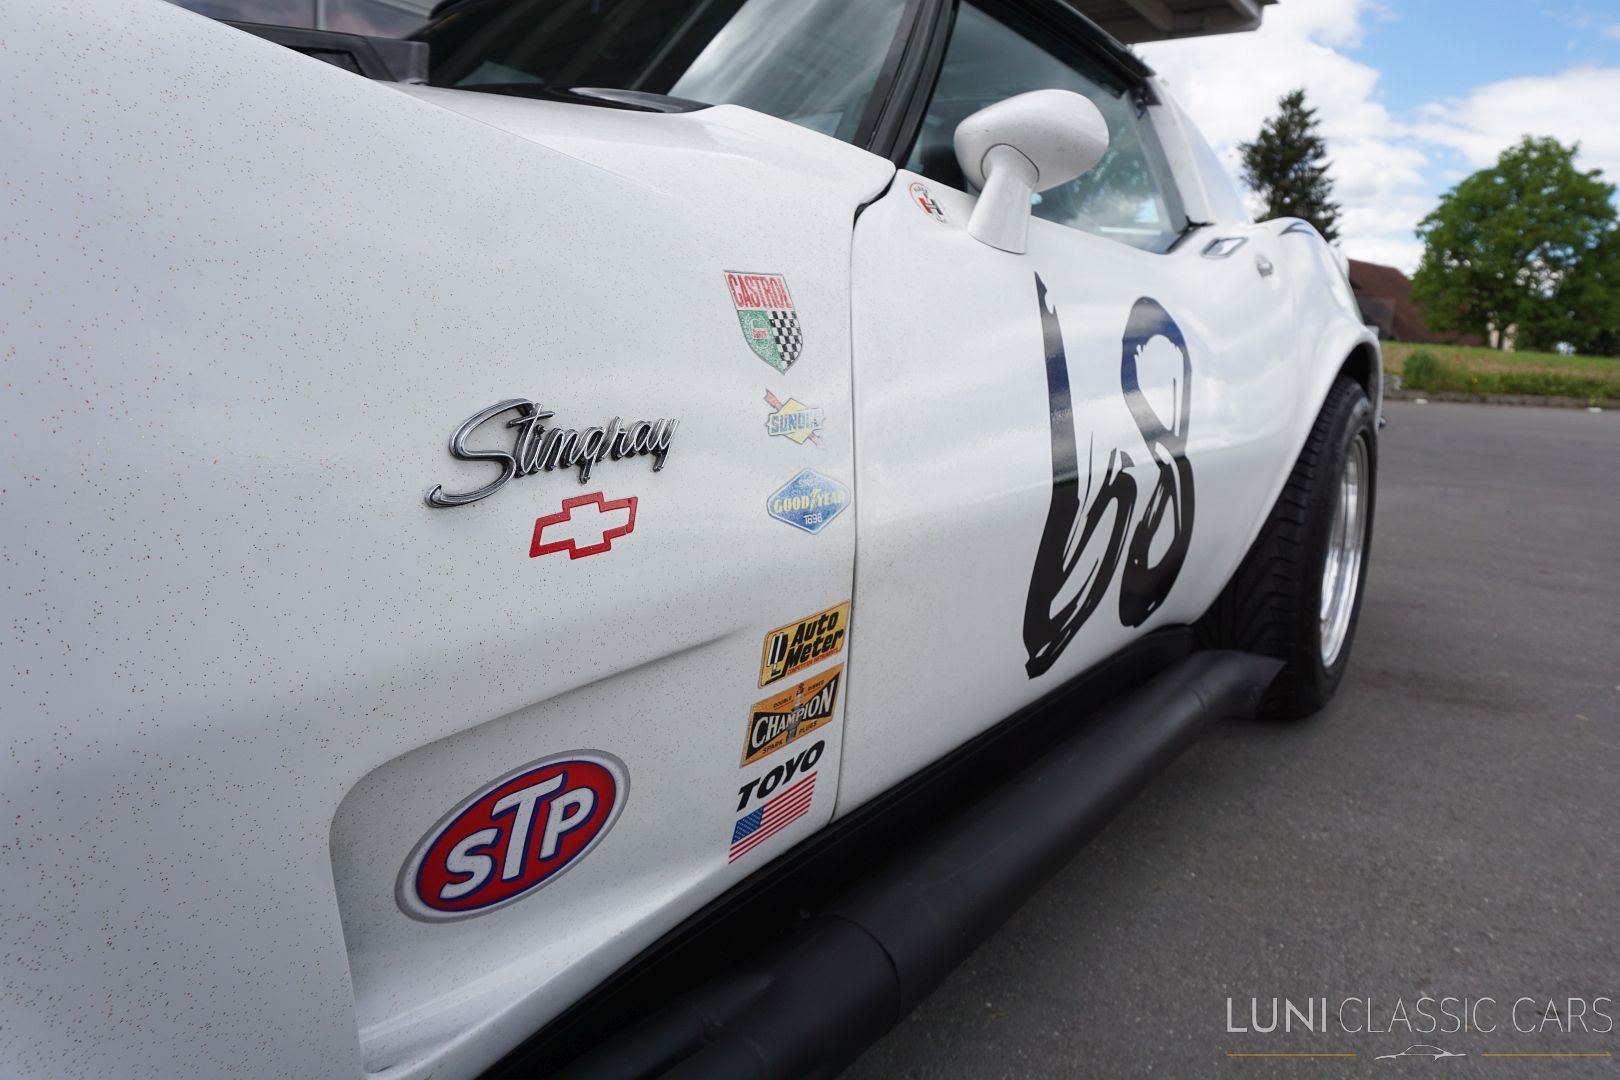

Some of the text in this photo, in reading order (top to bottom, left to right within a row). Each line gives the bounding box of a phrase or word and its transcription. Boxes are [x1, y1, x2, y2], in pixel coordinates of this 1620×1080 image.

[727, 273, 793, 309] CASTROL
[424, 397, 680, 508] Stingray
[781, 628, 844, 671] Meter
[790, 611, 839, 647] Auto
[751, 680, 835, 749] CHAMPION
[737, 739, 825, 812] TOYO
[439, 770, 597, 899] STP
